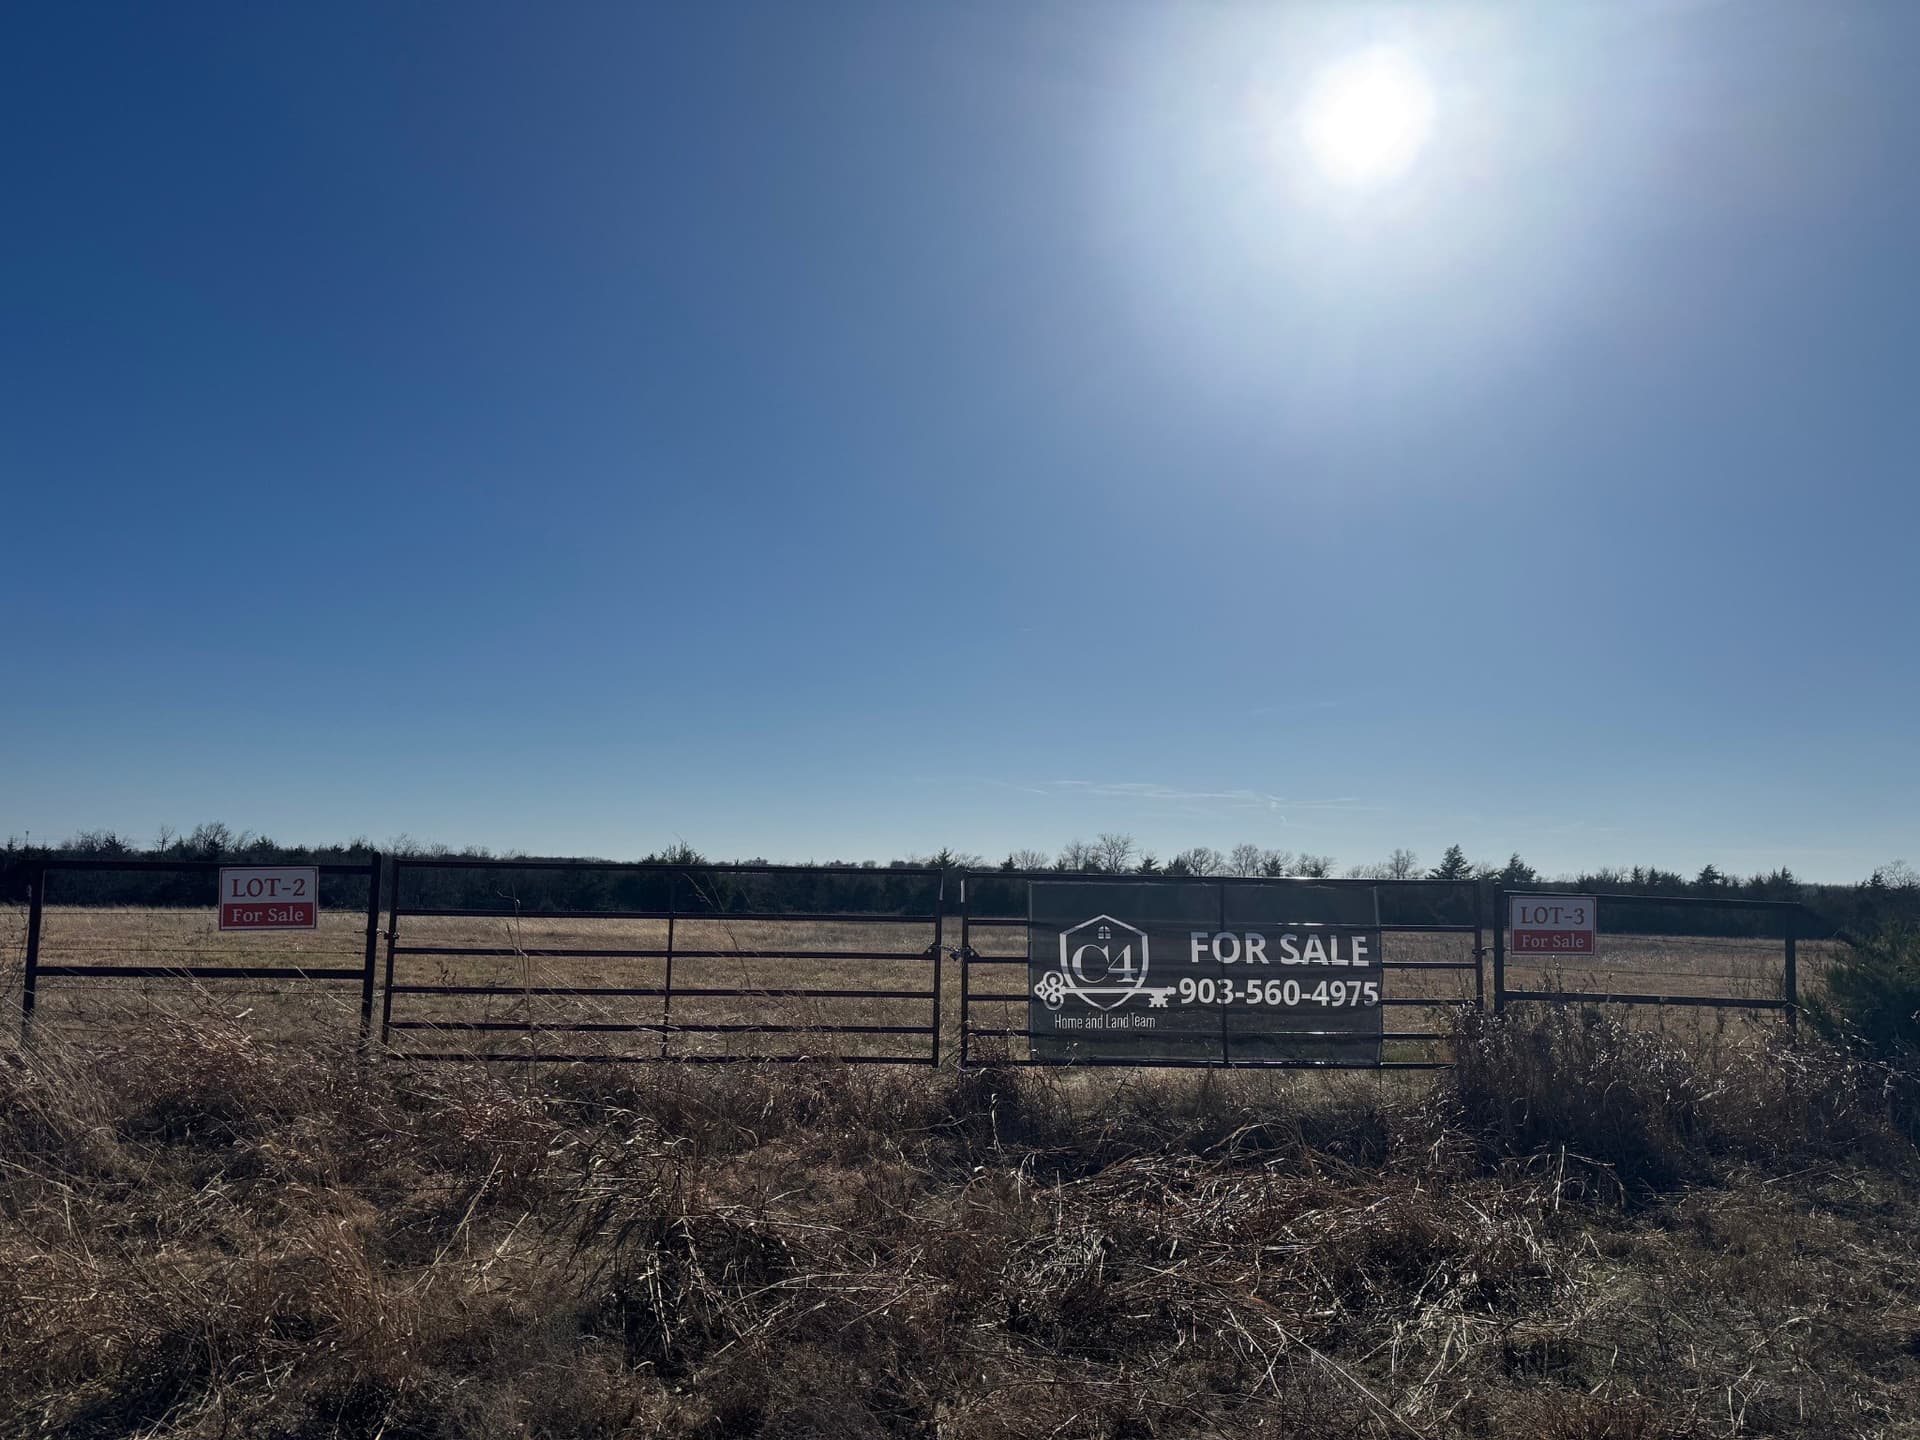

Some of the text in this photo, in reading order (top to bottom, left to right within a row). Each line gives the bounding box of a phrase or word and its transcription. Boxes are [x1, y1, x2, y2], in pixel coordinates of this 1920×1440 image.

[231, 878, 306, 897] LOT-2
[232, 905, 304, 923] For Sale
[1520, 906, 1585, 925] LOT-3
[1190, 931, 1370, 967] FOR SALE
[1522, 933, 1585, 948] For Sale
[1072, 944, 1139, 984] C4
[1178, 977, 1379, 1007] 903-560-4975
[1054, 1012, 1156, 1029] Home and Land Team
